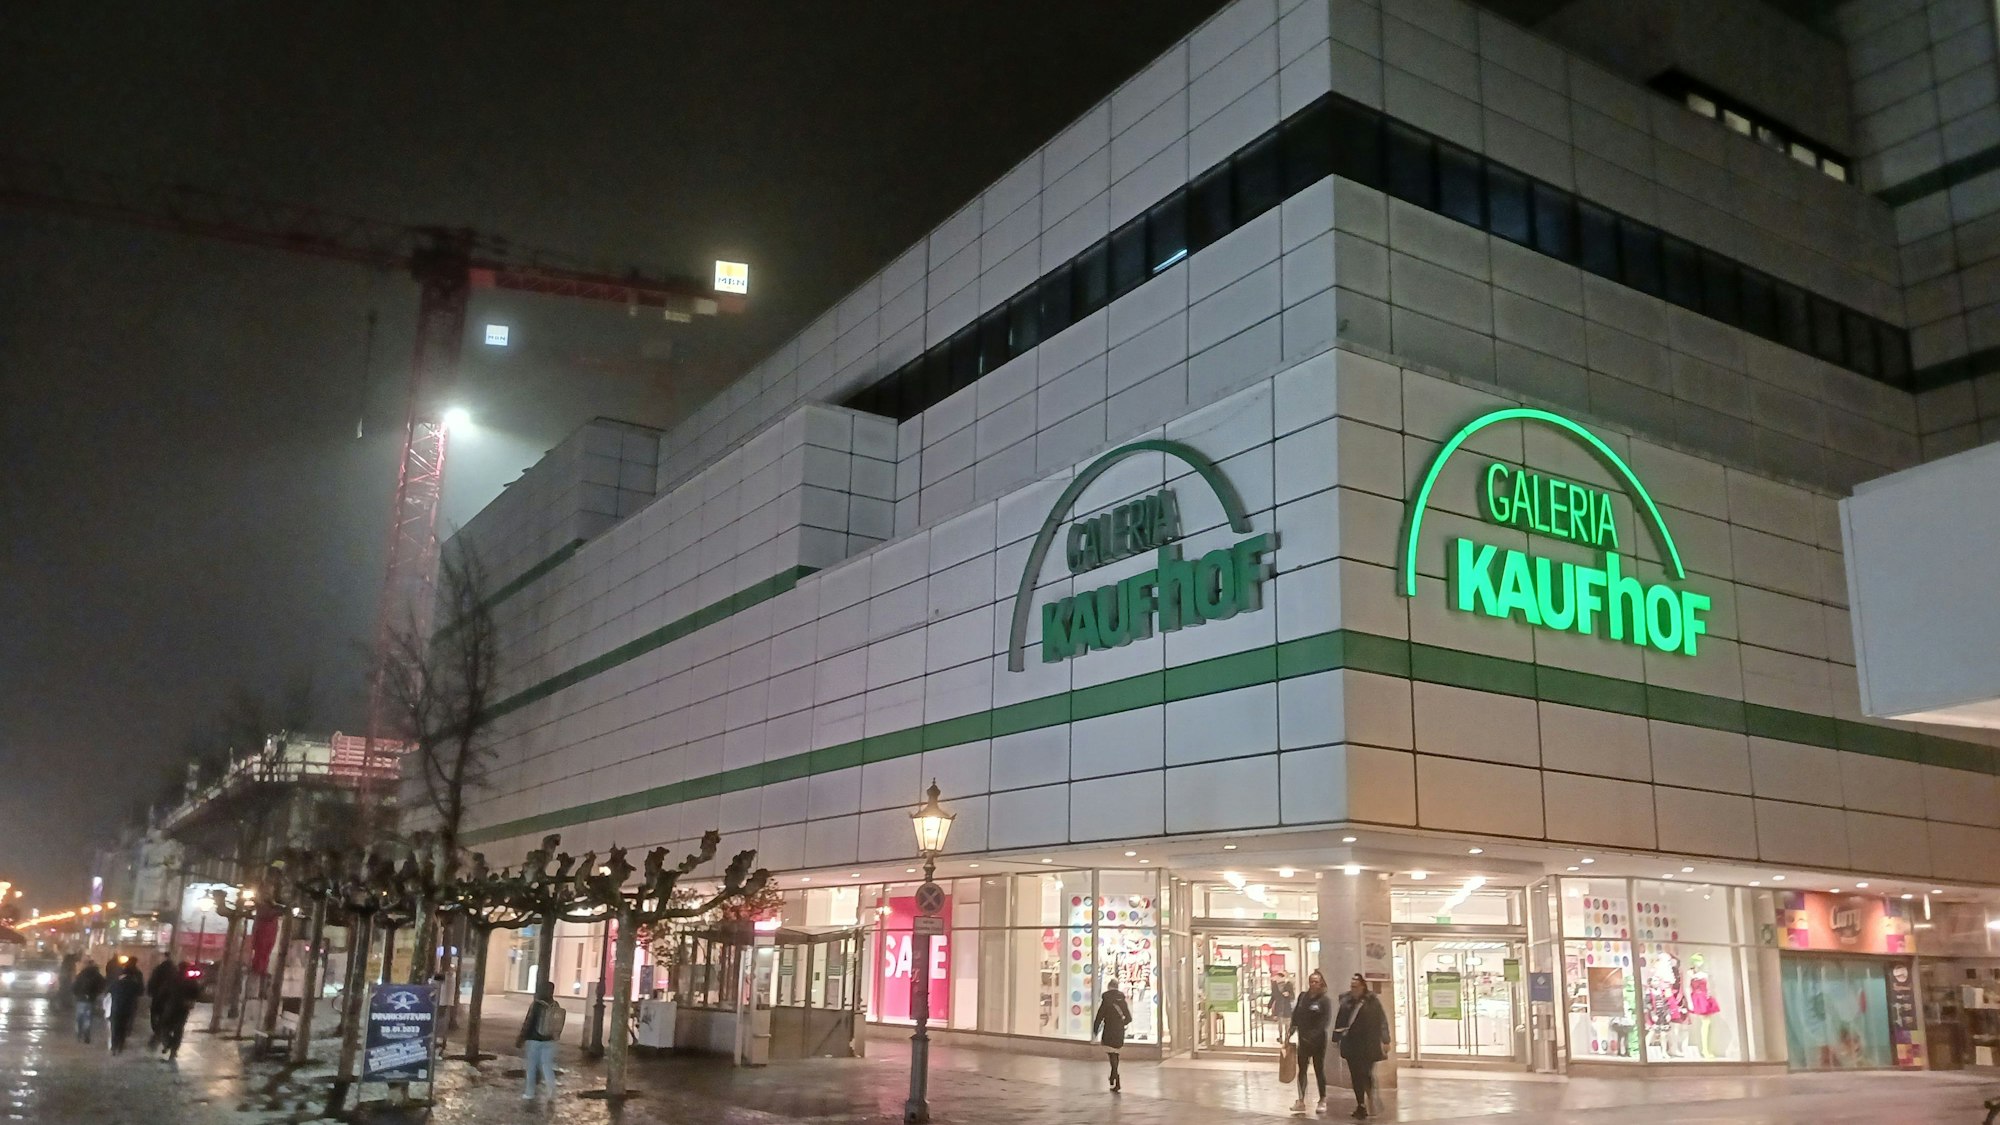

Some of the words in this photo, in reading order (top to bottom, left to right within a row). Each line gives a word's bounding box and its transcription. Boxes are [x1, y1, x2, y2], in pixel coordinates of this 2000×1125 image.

[718, 277, 745, 286] MBN
[1066, 488, 1182, 574] GALERIA
[1486, 463, 1619, 549] GALERIA
[885, 934, 948, 979] SAE
